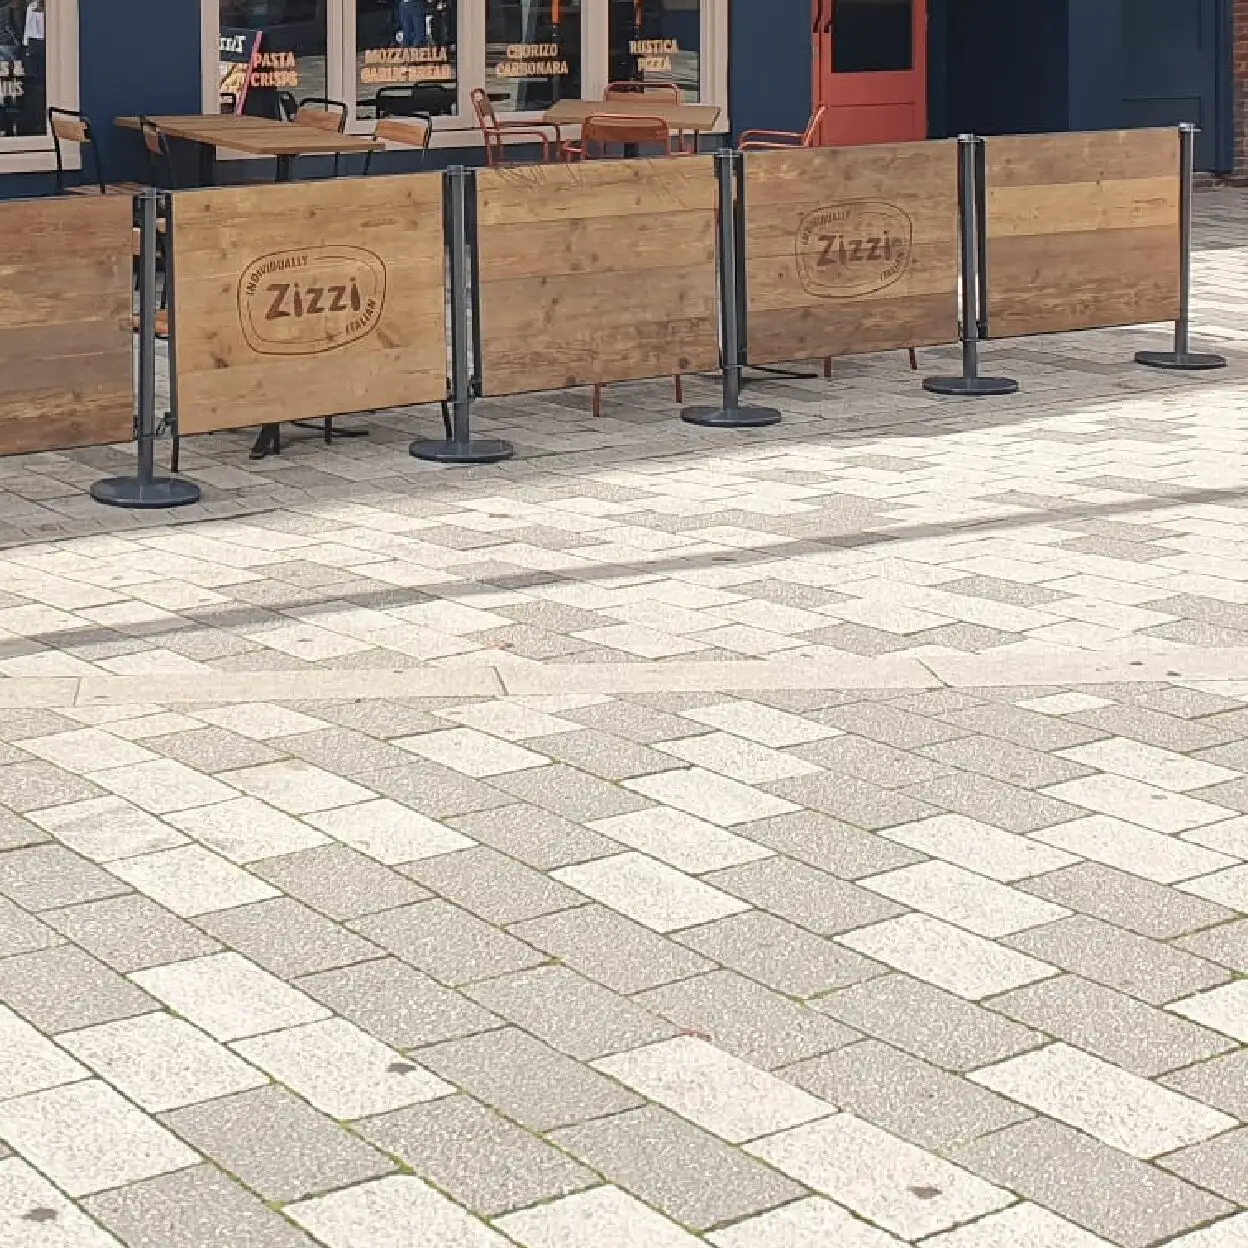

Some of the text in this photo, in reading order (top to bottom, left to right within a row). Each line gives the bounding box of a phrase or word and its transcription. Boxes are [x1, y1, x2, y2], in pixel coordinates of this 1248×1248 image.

[252, 51, 295, 68] PASTA
[816, 230, 891, 267] Zizzi
[264, 277, 361, 321] Zizzi
